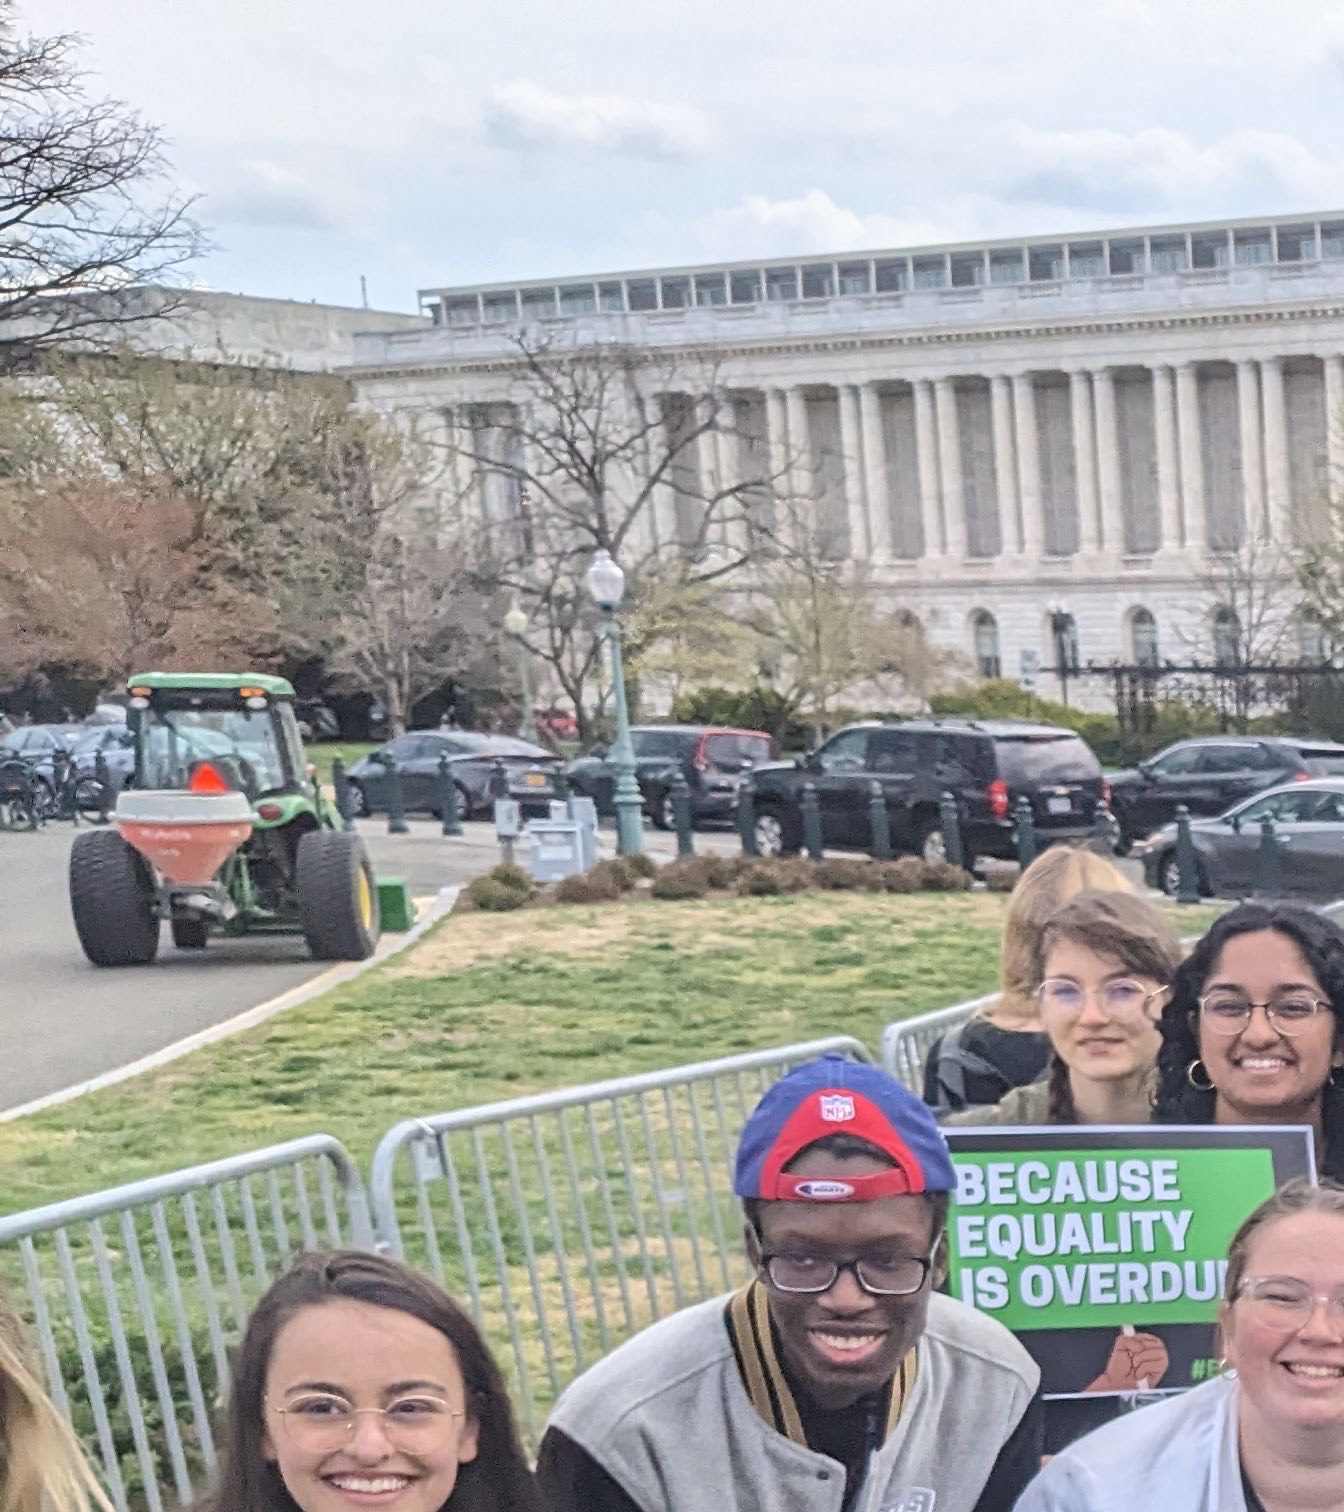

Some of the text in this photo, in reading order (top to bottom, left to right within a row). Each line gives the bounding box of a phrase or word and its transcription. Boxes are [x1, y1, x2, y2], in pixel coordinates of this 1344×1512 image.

[955, 1159, 1181, 1206] BECAUSE
[957, 1209, 1194, 1261] EQUALITY
[960, 1266, 1010, 1309] IS
